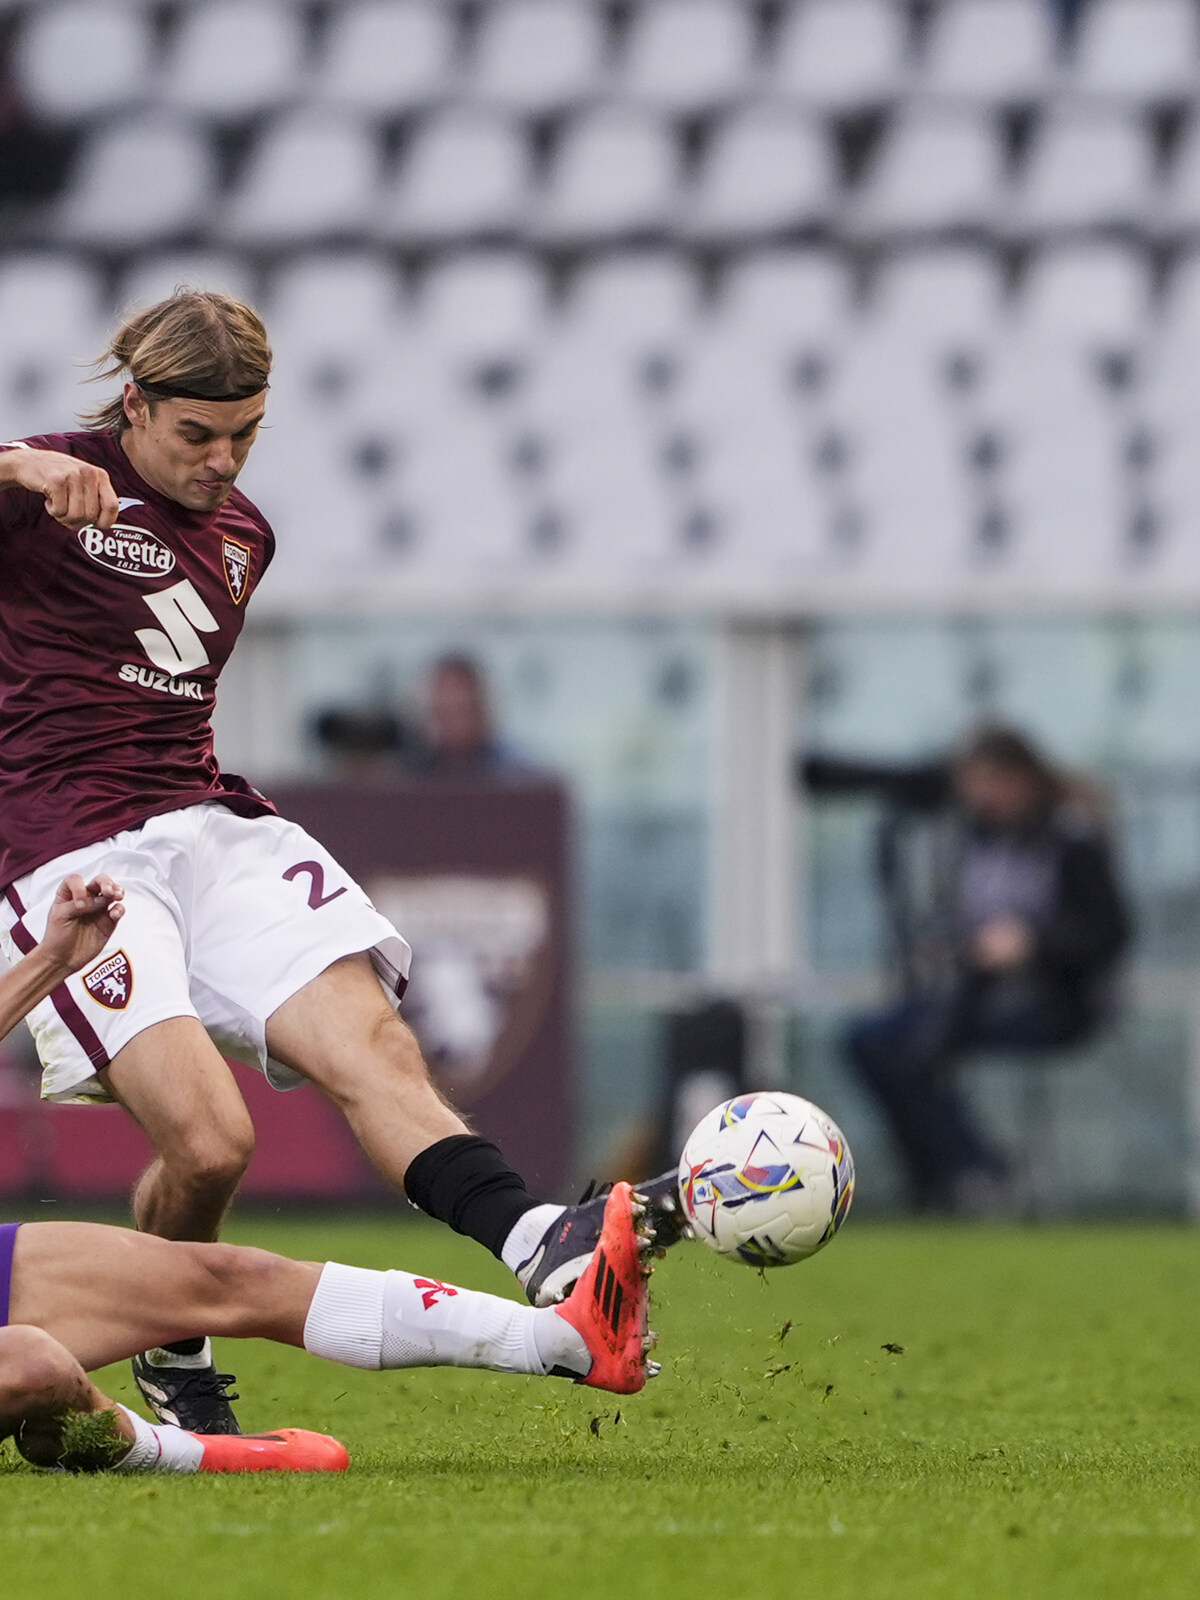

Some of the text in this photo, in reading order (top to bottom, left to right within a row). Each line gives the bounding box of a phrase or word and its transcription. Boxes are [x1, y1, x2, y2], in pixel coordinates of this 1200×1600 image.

[84, 527, 172, 570] Beretta
[117, 560, 140, 571] 1812
[118, 663, 204, 701] SUZUKI
[88, 957, 122, 984] TORINO
